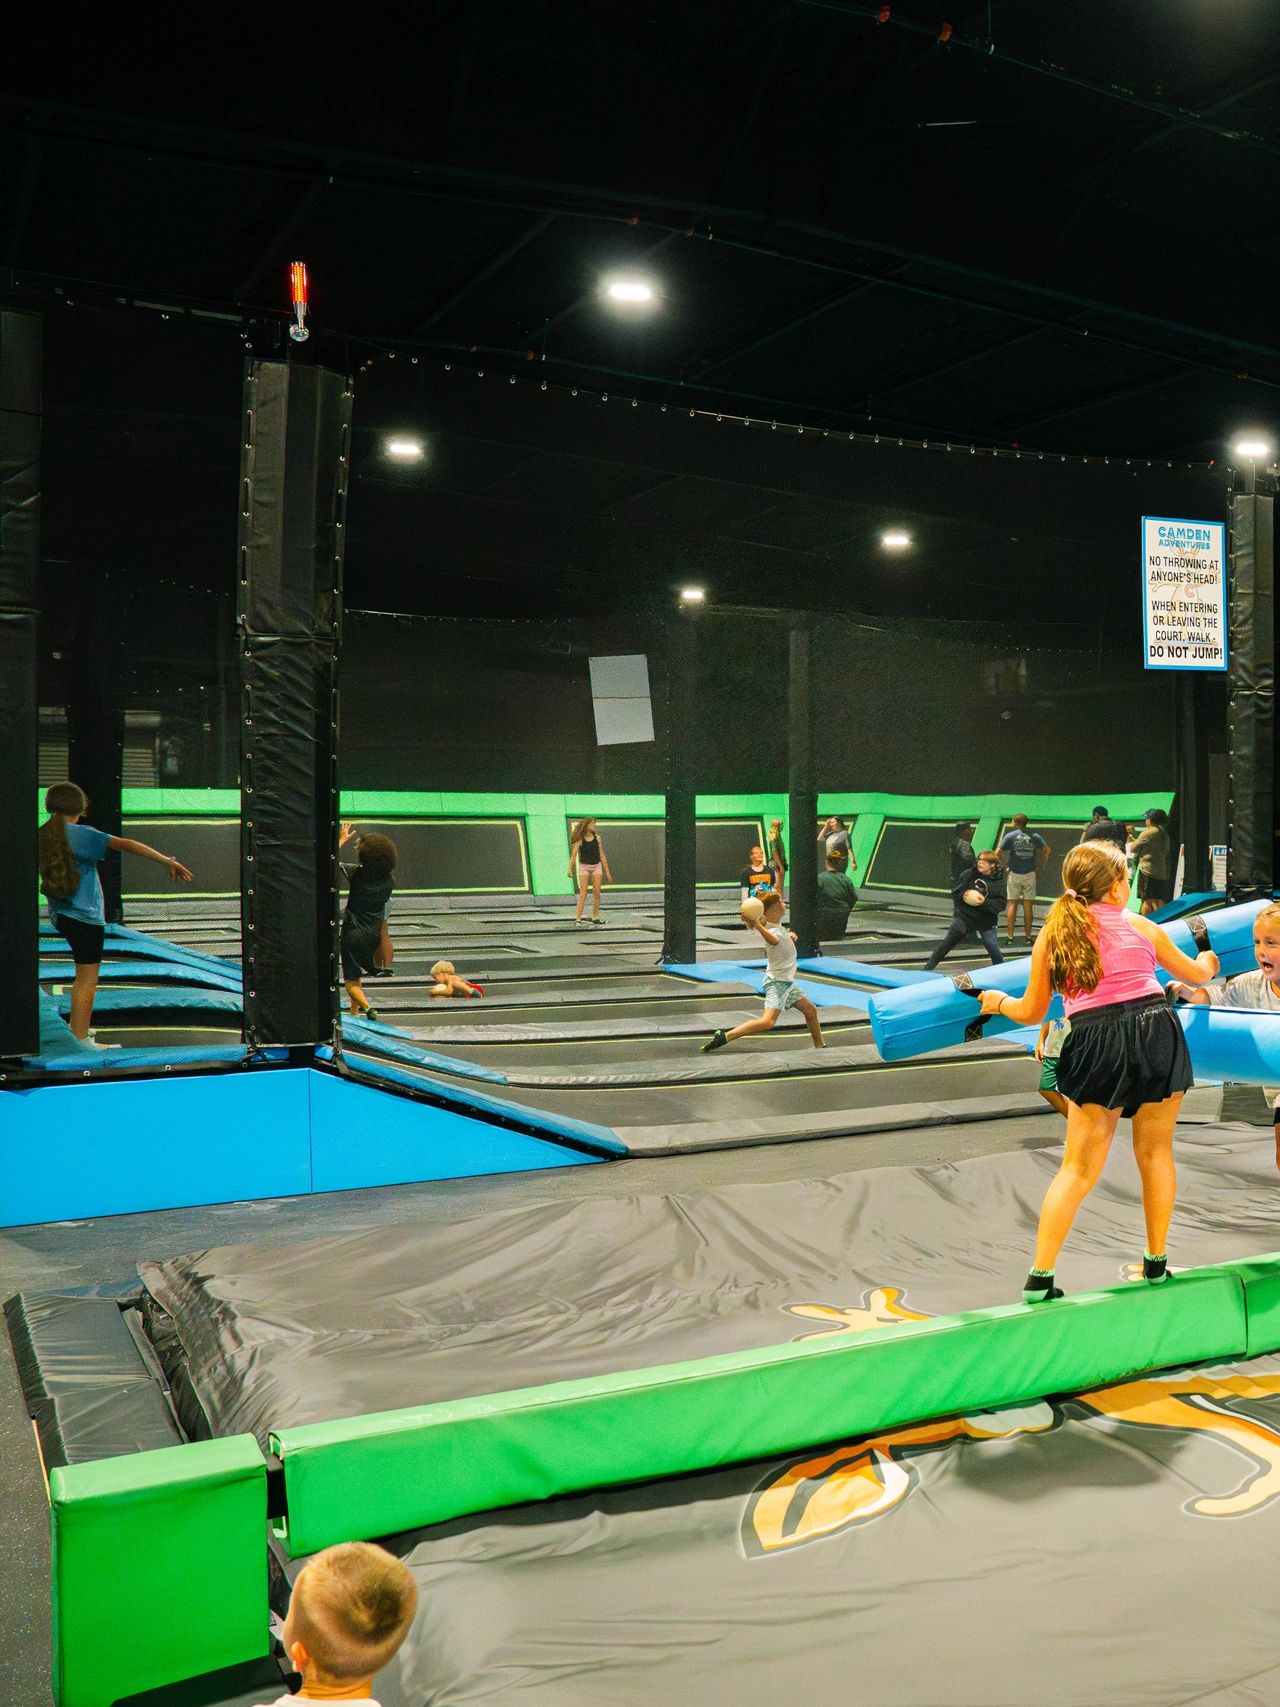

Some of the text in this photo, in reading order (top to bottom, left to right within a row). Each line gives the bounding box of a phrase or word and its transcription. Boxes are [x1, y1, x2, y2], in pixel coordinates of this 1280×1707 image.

[1158, 527, 1210, 541] CAMDEN
[1158, 539, 1210, 550] ADVENTURES
[1150, 556, 1219, 570] NO THROWING AT
[1151, 572, 1218, 585] ANYONE'S HEAD!
[1152, 600, 1218, 614] WHEN ENTERING
[1153, 616, 1218, 628] OR LEAVING THE
[1188, 632, 1211, 642] WALK
[1150, 646, 1222, 659] DO NOT JUMP!
